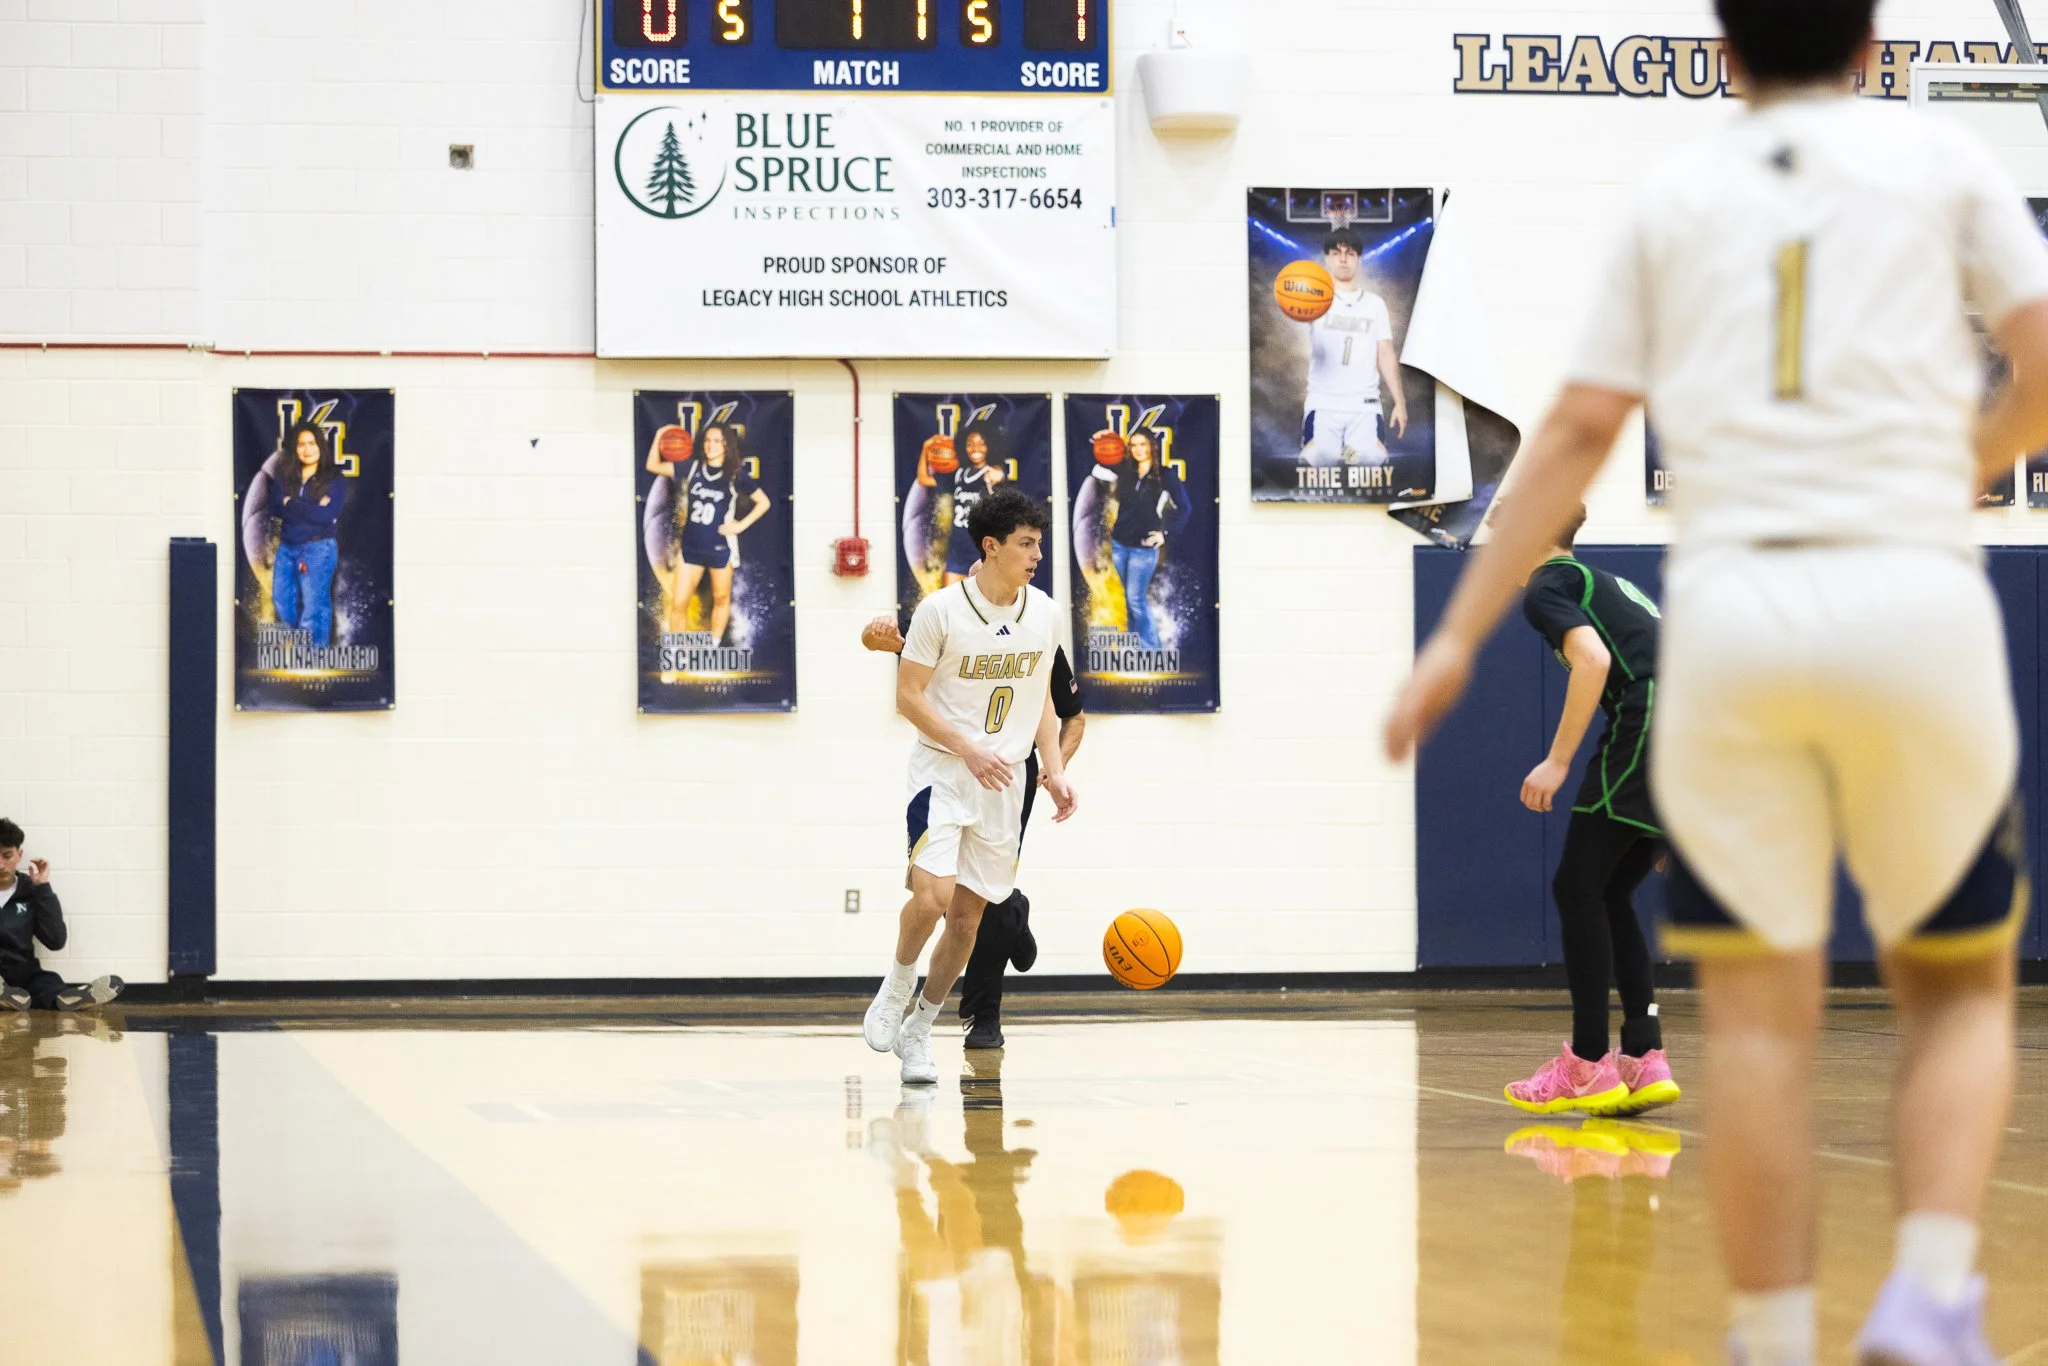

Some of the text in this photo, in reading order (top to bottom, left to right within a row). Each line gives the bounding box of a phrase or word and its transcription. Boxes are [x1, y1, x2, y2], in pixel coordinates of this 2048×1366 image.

[718, 0, 745, 41] 5
[967, 0, 993, 43] 5
[610, 58, 691, 84] SCORE
[813, 60, 900, 85] MATCH
[1020, 61, 1100, 87] SCORE
[736, 113, 836, 149] BLUE
[944, 121, 1064, 132] NO. 1 PROVIDER OF
[926, 143, 1082, 155] COMMERCIAL AND HOME
[735, 156, 896, 193] SPRUCE
[962, 167, 1047, 178] INSPECTIONS
[927, 188, 1083, 209] 303-317-6654
[734, 207, 900, 220] INSPECTIONS
[764, 257, 947, 274] PROUD SPONSOR OF
[703, 289, 1008, 307] LEGACY HIGH SCHOOL ATHLETICS
[1775, 241, 1809, 398] 1
[1295, 466, 1394, 489] TRAE BURY
[690, 500, 716, 526] 20
[1089, 632, 1140, 648] SOPHIA
[259, 646, 379, 670] MOLINA ROMERO
[661, 648, 752, 672] SCHMIDT
[958, 650, 1043, 679] LEGACY
[1090, 649, 1179, 673] DINGMAN
[984, 686, 1014, 735] 0
